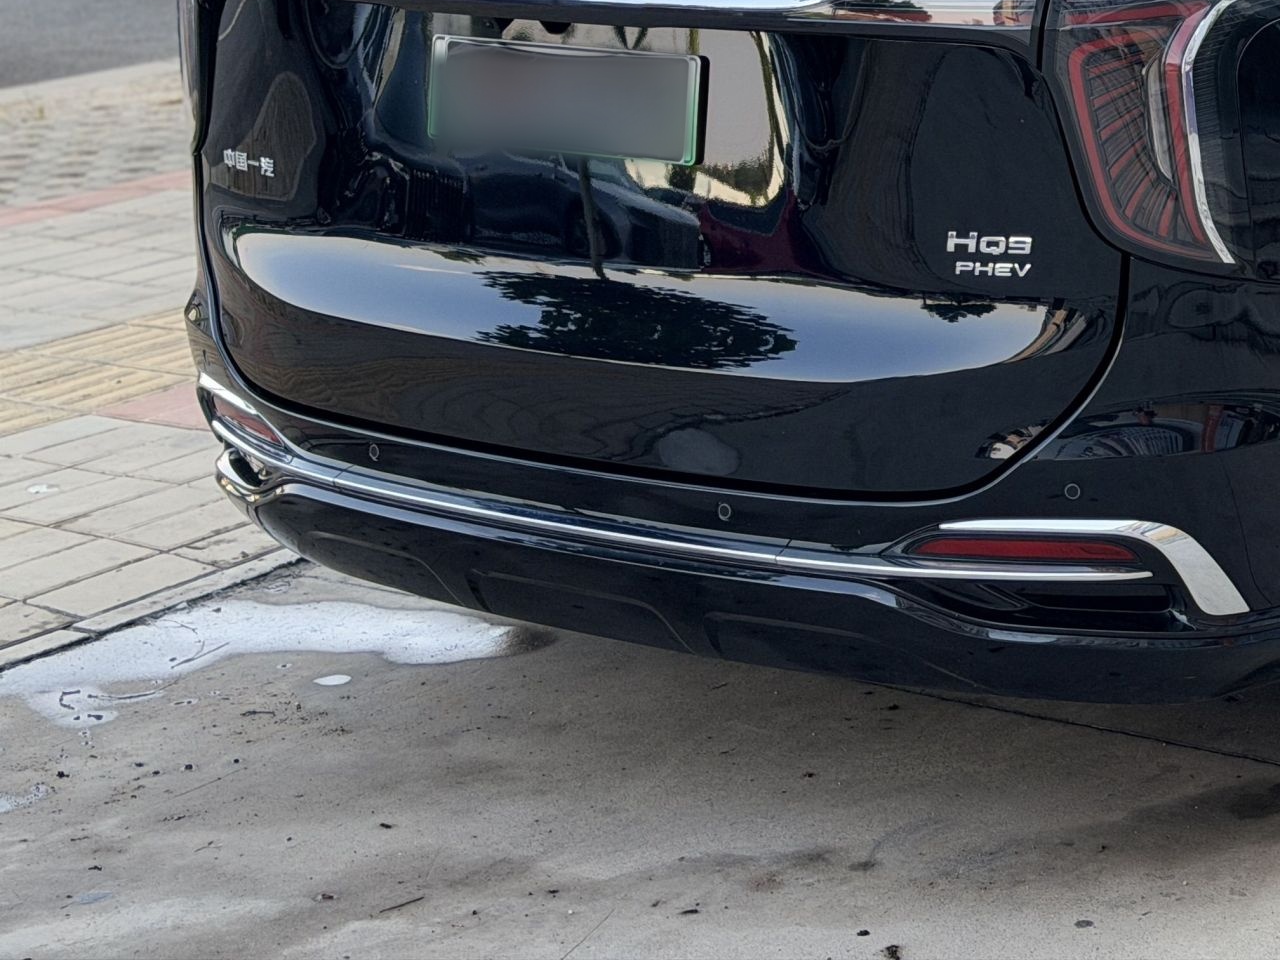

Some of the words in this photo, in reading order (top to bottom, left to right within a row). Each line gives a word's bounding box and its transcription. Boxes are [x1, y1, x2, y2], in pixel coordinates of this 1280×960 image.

[223, 148, 275, 178] 中国一汽
[946, 231, 1032, 255] HQ9
[955, 261, 1032, 277] PHEV
